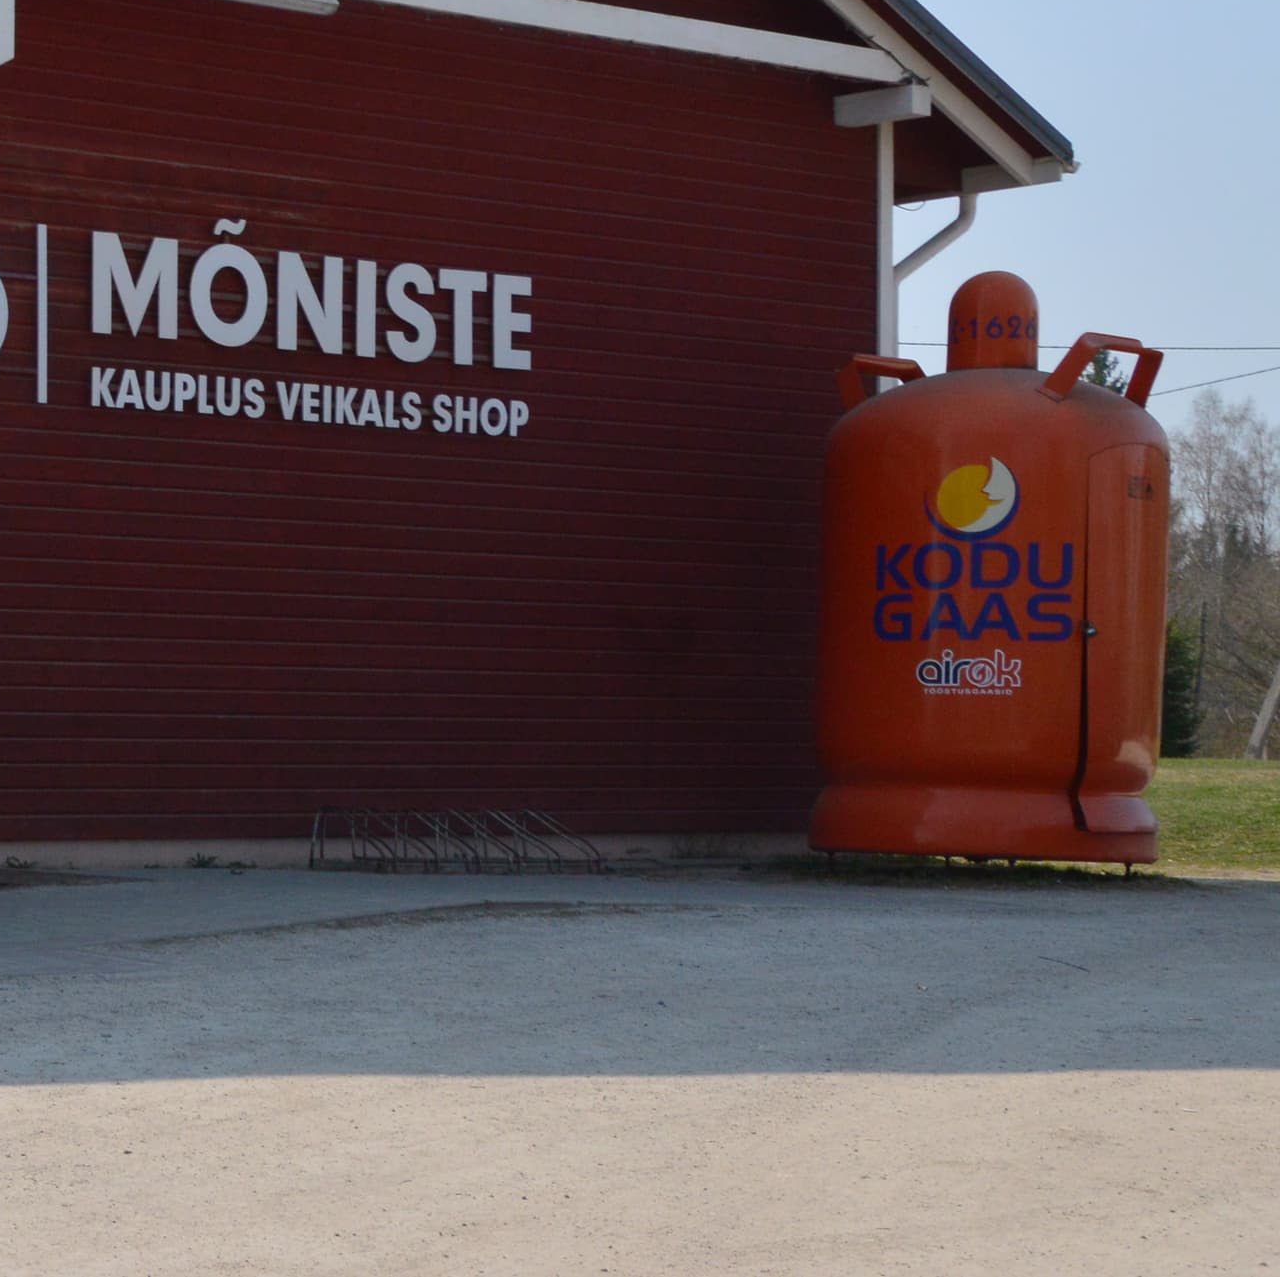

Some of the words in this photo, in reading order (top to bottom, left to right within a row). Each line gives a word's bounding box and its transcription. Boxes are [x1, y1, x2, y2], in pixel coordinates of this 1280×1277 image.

[91, 218, 532, 370] MÕNISTE
[90, 366, 267, 419] KAUPLUS
[276, 381, 424, 430] VEIKALS
[432, 394, 532, 437] SHOP
[876, 542, 1073, 590] KODU
[873, 592, 1073, 642] GAAS
[916, 648, 1022, 688] airok
